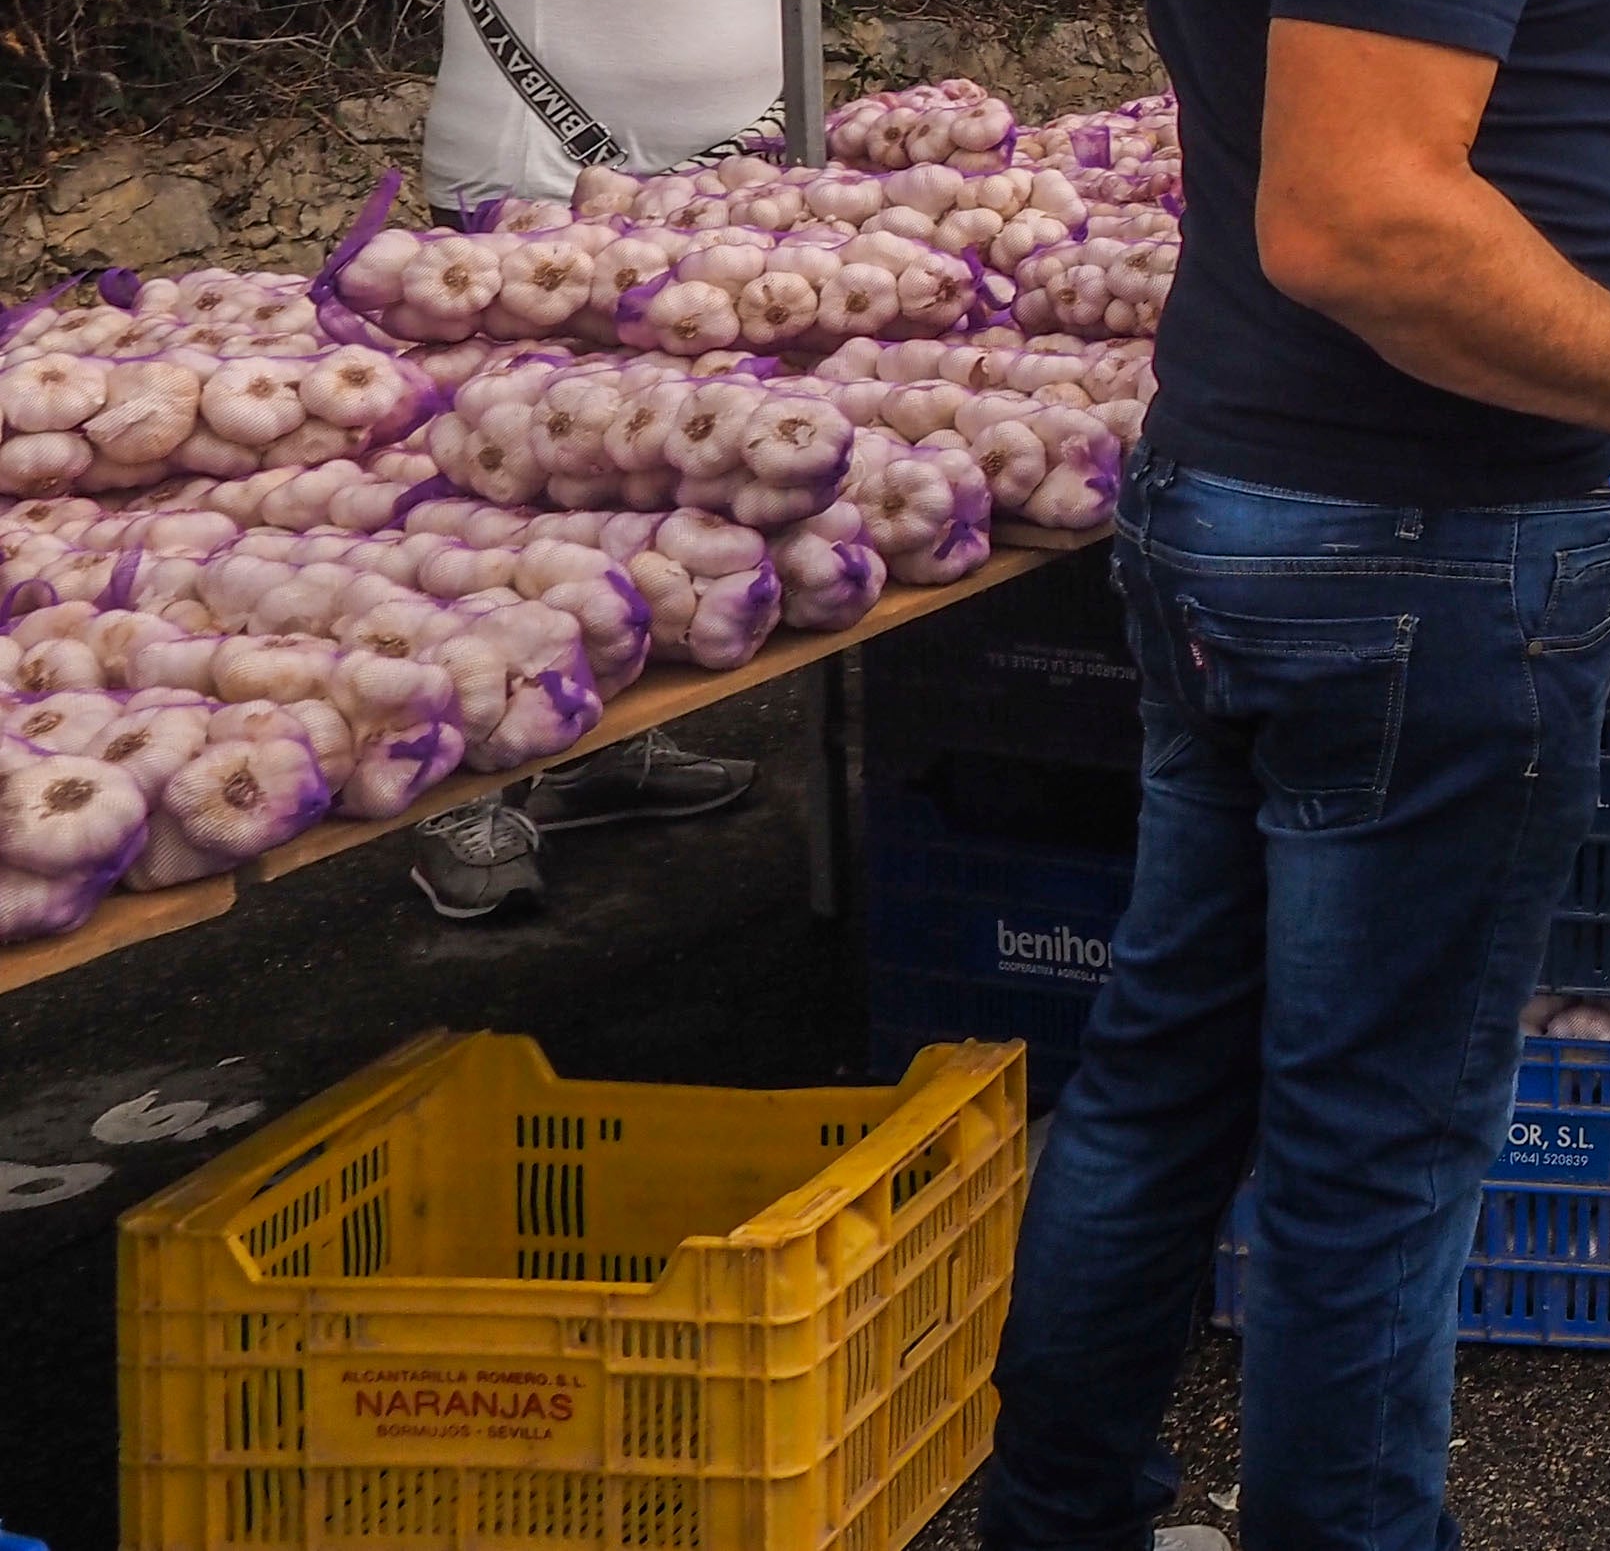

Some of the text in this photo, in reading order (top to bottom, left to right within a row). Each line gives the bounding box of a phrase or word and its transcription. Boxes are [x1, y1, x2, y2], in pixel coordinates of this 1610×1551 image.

[1508, 1123, 1595, 1150] OR, S.L.
[1509, 1151, 1540, 1167] (964)
[1542, 1153, 1589, 1167] 520839
[341, 1369, 468, 1384] ALCANTARILLA
[354, 1389, 574, 1422] NARANJAS
[376, 1423, 471, 1439] BORMUJOS
[487, 1425, 554, 1440] SEVILLA
